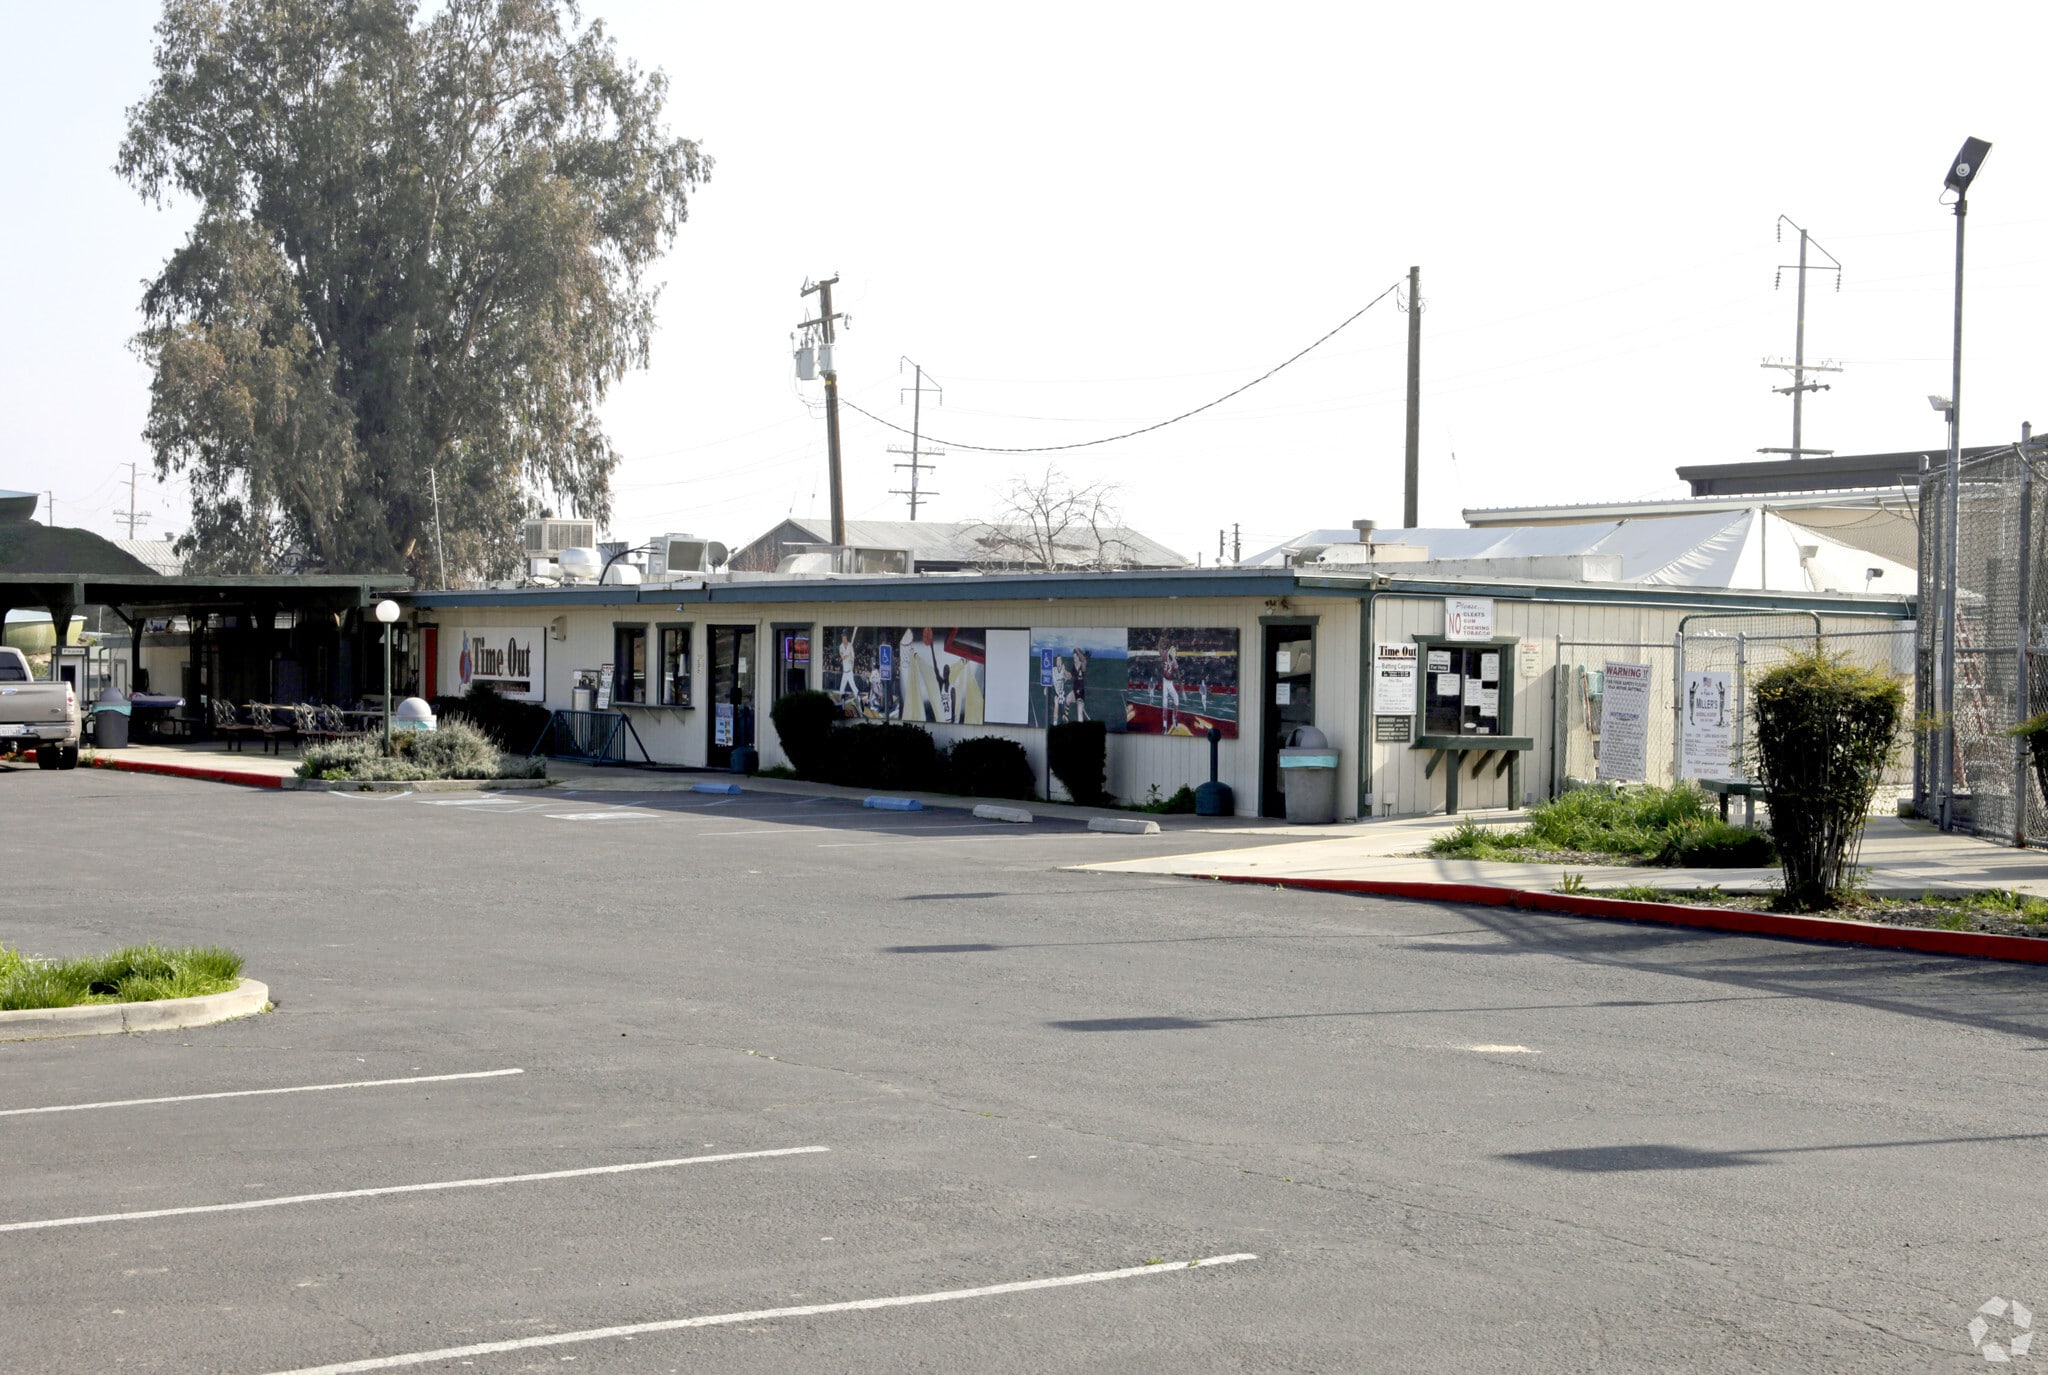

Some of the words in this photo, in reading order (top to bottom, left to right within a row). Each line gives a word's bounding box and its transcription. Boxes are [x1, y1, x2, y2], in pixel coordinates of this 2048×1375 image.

[1449, 612, 1461, 635] NO
[472, 637, 504, 677] Time
[508, 637, 531, 678] Out
[1379, 646, 1400, 657] Time
[1402, 646, 1417, 657] Out
[1606, 666, 1642, 678] WARNING
